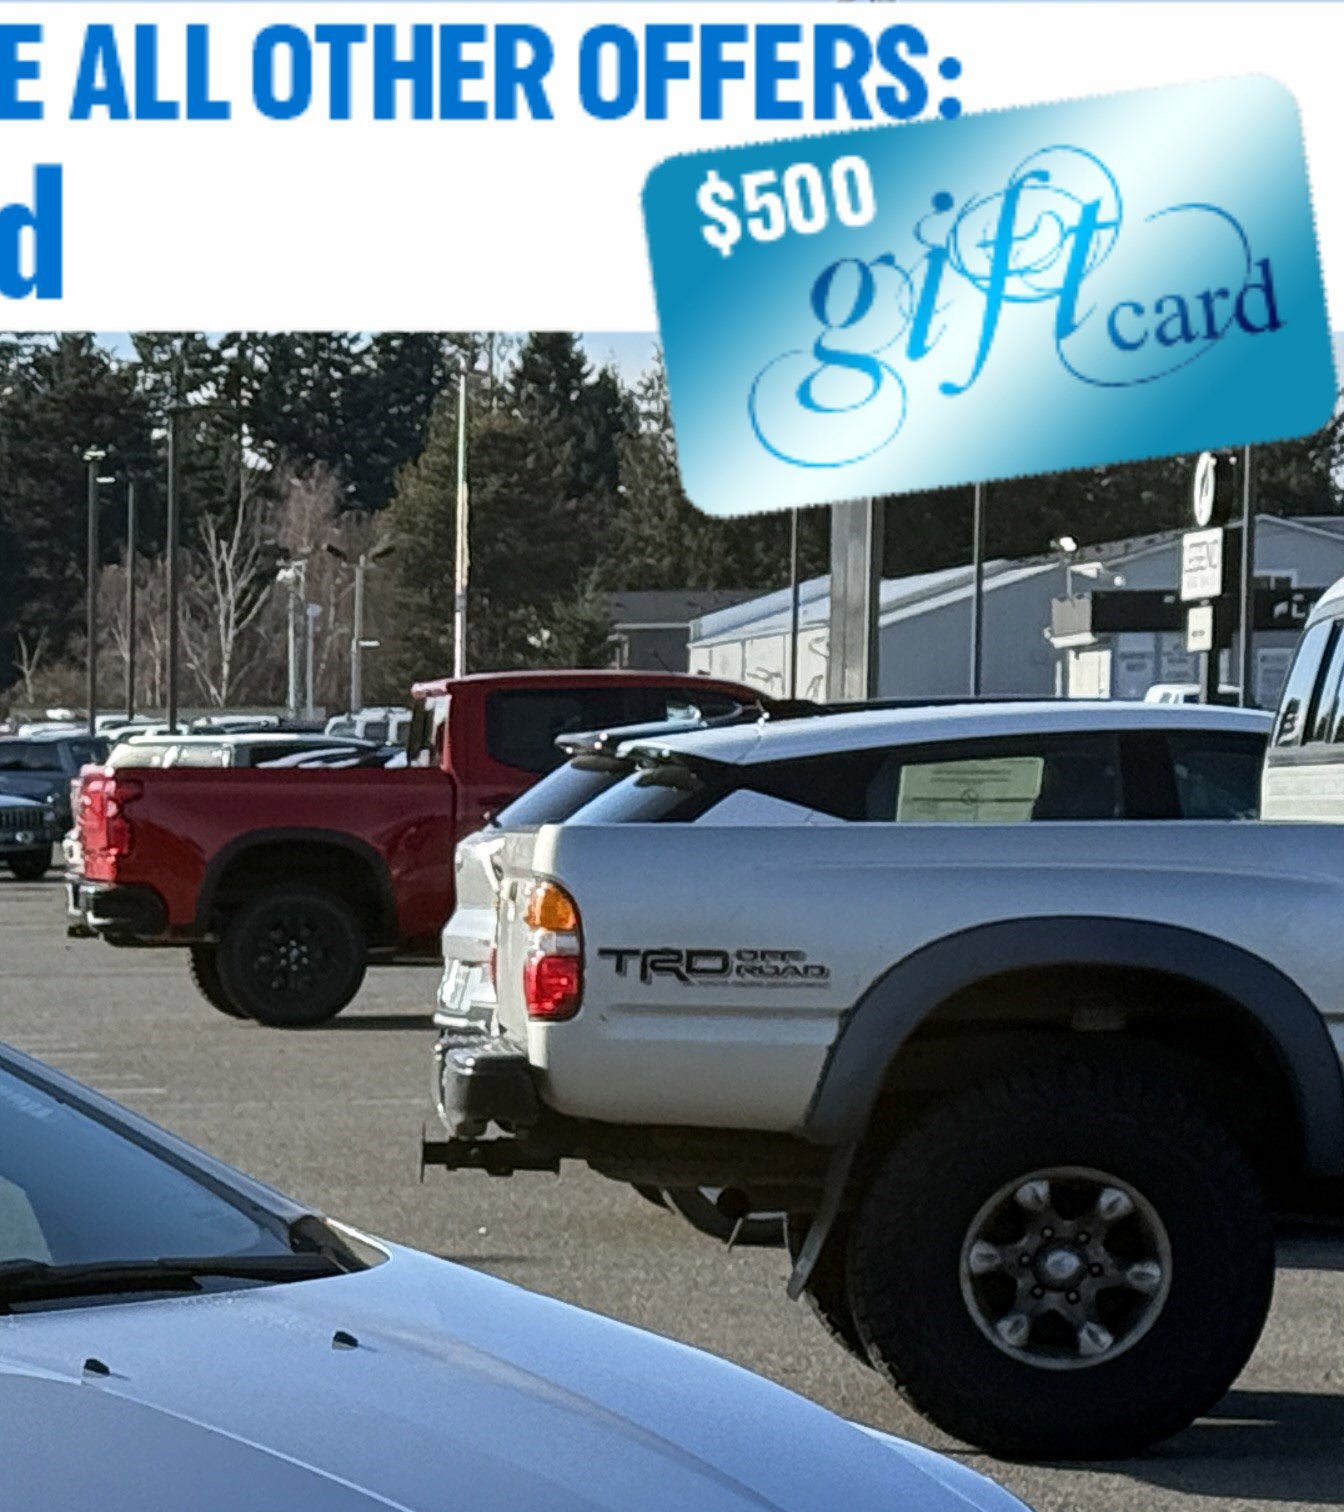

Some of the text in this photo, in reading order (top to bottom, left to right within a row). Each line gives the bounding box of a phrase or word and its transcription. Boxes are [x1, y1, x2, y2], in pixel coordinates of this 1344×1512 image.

[734, 948, 807, 963] OFF
[597, 947, 734, 985] TRD
[735, 964, 831, 979] ROAD
